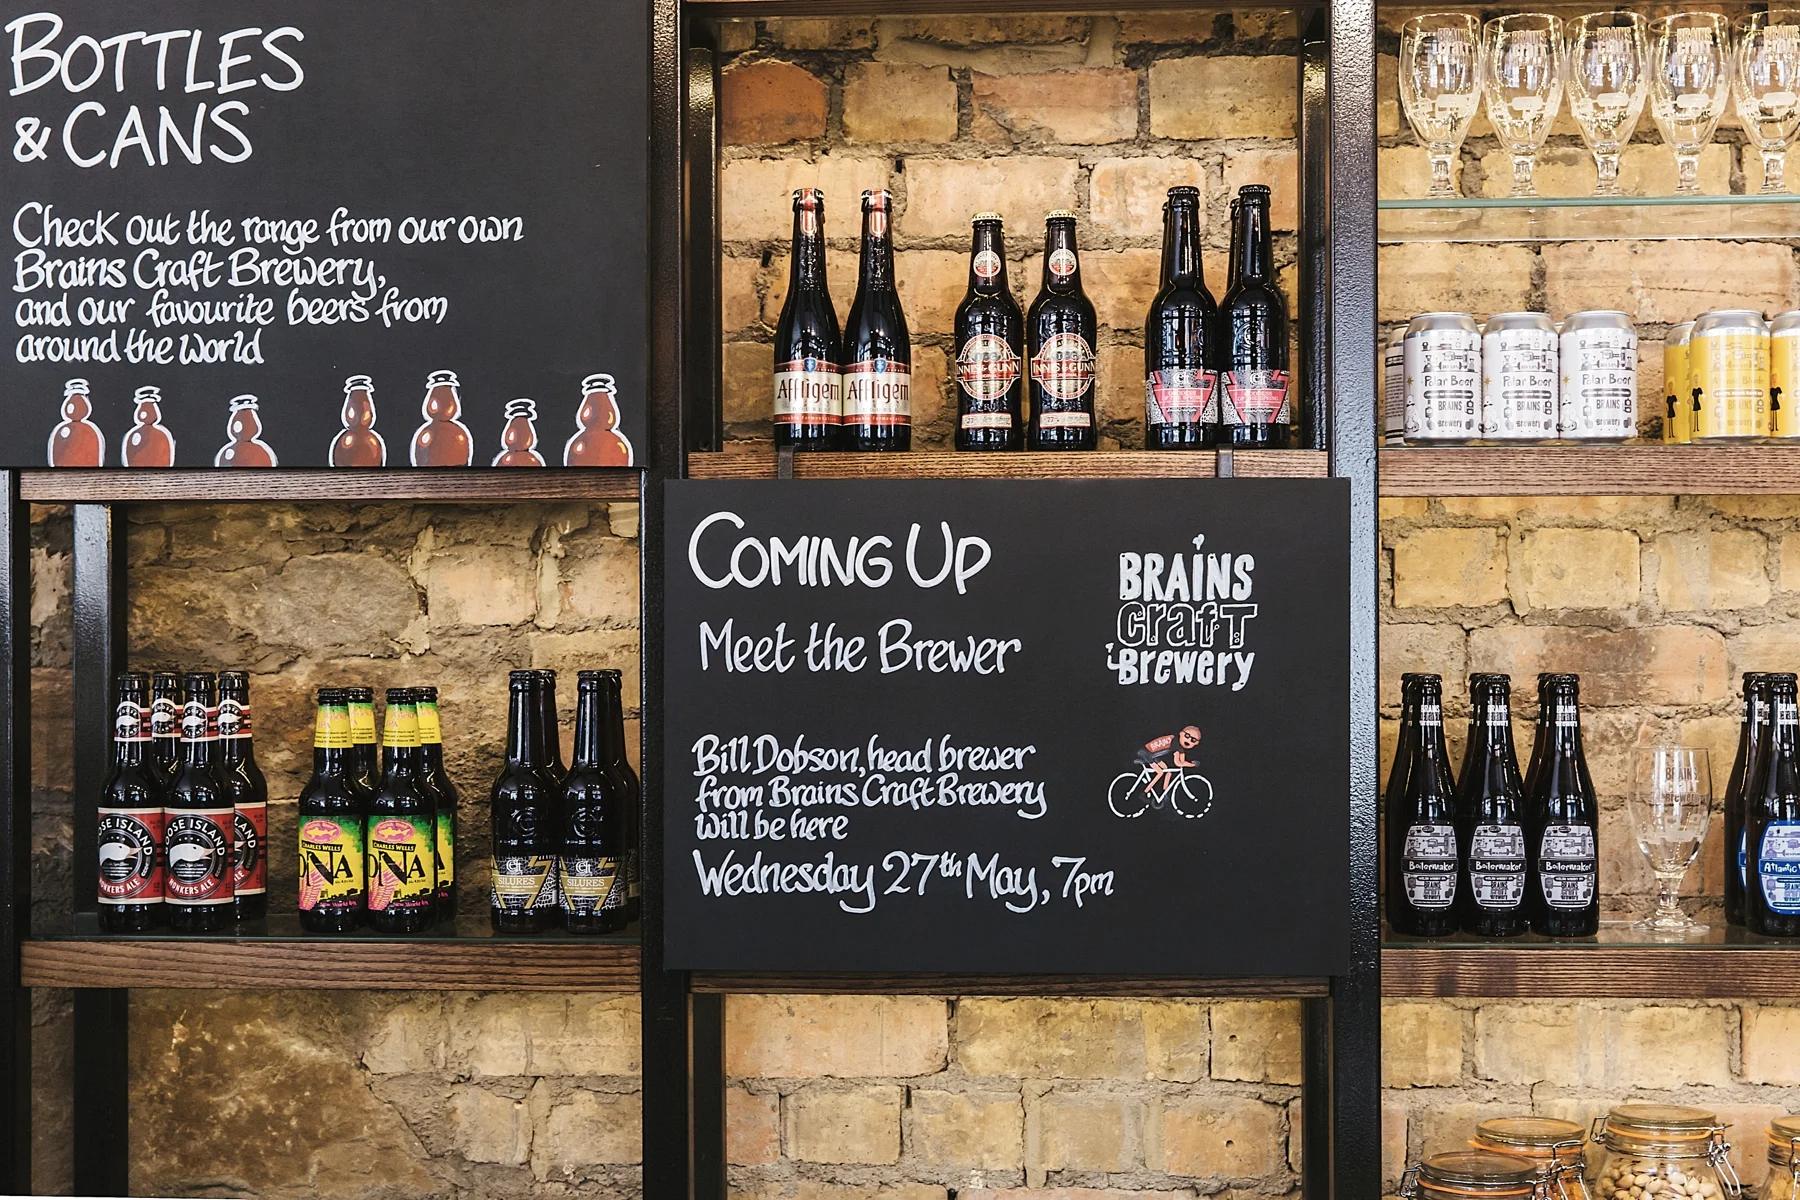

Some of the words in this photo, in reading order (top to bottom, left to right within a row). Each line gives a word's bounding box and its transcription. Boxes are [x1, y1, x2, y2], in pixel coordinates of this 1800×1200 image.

[5, 12, 304, 96] BOTTLES
[13, 117, 51, 162] &
[63, 101, 252, 169] CANS
[13, 202, 120, 247] Check
[186, 209, 235, 246] the
[241, 216, 320, 256] range
[326, 207, 391, 247] from
[398, 217, 456, 244] our
[458, 216, 524, 243] own
[12, 248, 127, 293] Brains
[133, 248, 224, 290] Craft
[227, 246, 387, 300] Brewery,
[15, 292, 71, 327] and
[78, 297, 135, 326] our
[146, 288, 275, 328] favourite
[287, 287, 369, 326] beers
[375, 287, 448, 328] from
[16, 329, 121, 363] around
[124, 328, 174, 364] the
[777, 379, 839, 403] Affligem
[847, 379, 909, 404] Affligem
[1424, 375, 1448, 387] Polar
[1503, 375, 1526, 387] Polar
[1582, 374, 1606, 385] Polar
[1438, 401, 1462, 411] BRAINS
[1516, 401, 1541, 411] BRAINS
[1596, 399, 1621, 409] BRAINS
[688, 512, 893, 589] COMING
[905, 521, 991, 594] UP
[1119, 534, 1254, 602] BRAINS
[700, 618, 795, 673] Meet
[804, 622, 867, 672] the
[878, 618, 1021, 675] Brewer
[1106, 643, 1255, 691] Brewery
[692, 734, 751, 776] Bill
[752, 734, 865, 777] Dobson,
[867, 734, 932, 773] head
[938, 734, 1036, 773] brewer
[695, 775, 763, 812] from
[768, 775, 859, 808] Brains
[862, 774, 935, 811] Craft
[936, 773, 1047, 819] Brewery
[116, 818, 153, 856] ISLAND
[190, 819, 226, 856] ISLAND
[234, 816, 256, 848] LAND
[753, 809, 786, 840] be
[790, 808, 848, 840] here
[394, 844, 415, 852] WELLS
[1409, 861, 1455, 871] Boilermaker
[1475, 861, 1521, 871] Boilermaker
[1545, 861, 1592, 871] Boilermaker
[1764, 862, 1797, 873] Atlantic
[126, 878, 141, 891] ALE
[168, 878, 199, 895] HONKERS
[200, 879, 215, 893] ALE
[497, 877, 536, 886] SILURES
[566, 879, 605, 887] SILURES
[693, 850, 875, 913] Wednesday
[882, 851, 962, 896] 27th
[965, 852, 1050, 913] May,
[1051, 855, 1114, 908] 7pm
